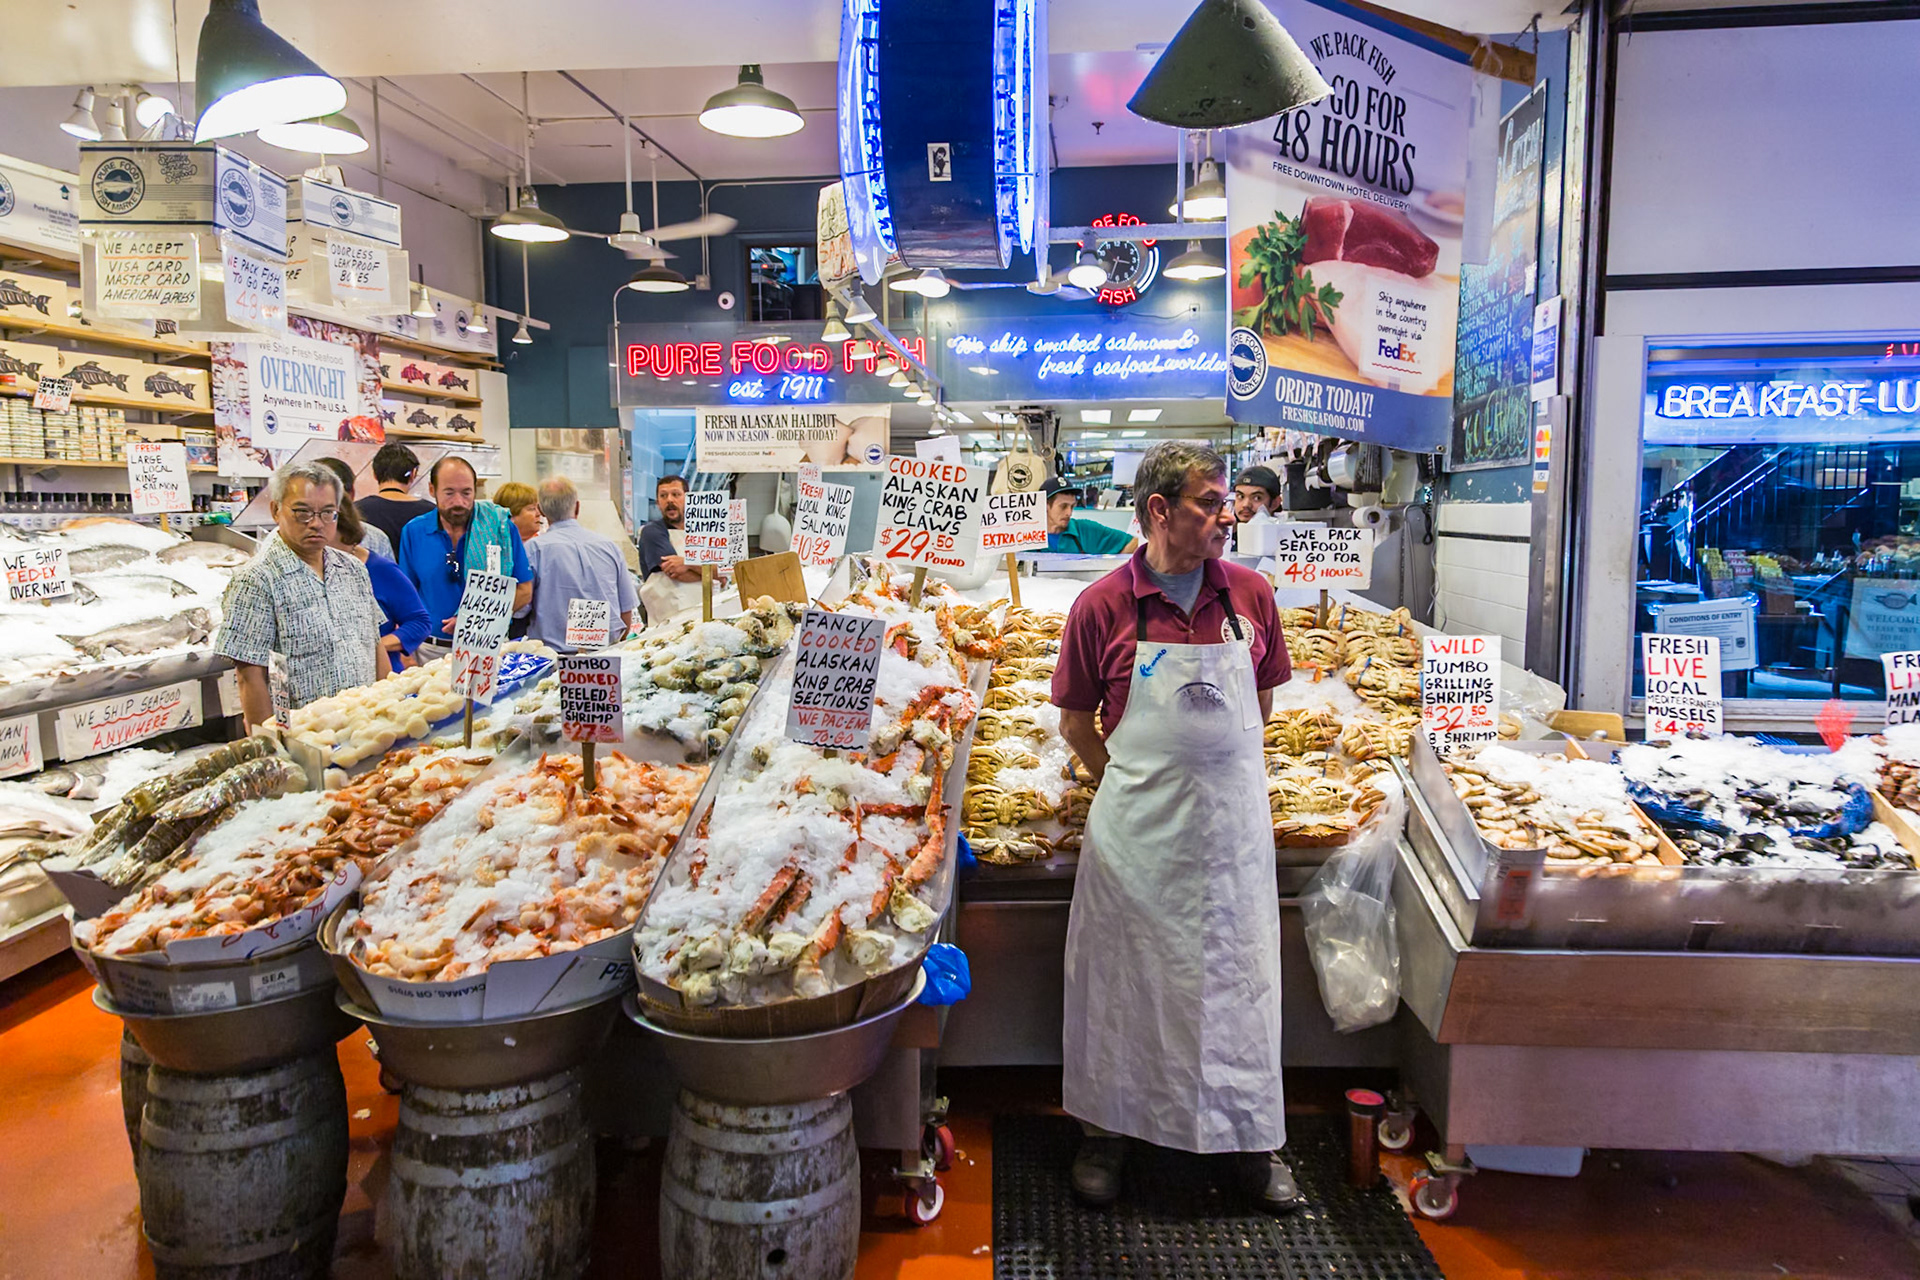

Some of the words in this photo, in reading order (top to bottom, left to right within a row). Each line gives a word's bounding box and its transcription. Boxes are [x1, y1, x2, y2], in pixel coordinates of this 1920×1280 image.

[1310, 33, 1334, 62] WE
[1334, 31, 1368, 63] PACK
[1368, 45, 1396, 86] FISH
[1330, 74, 1360, 120] GO
[1364, 86, 1407, 138] FOR
[1273, 109, 1311, 163] 48
[1318, 114, 1416, 197] HOURS
[97, 162, 116, 180] PURE
[120, 160, 140, 180] FOOD
[1272, 161, 1292, 177] FREE
[1294, 168, 1345, 192] DOWNTOWN
[1346, 186, 1372, 200] HOTEL
[1373, 192, 1412, 211] DELIVERY!
[111, 190, 140, 210] MARKET
[103, 242, 122, 254] WE
[129, 242, 184, 254] ACCEPT
[330, 244, 374, 260] ODORLESS
[109, 261, 140, 272] VISA
[146, 260, 183, 272] CARD
[228, 256, 238, 270] WE
[241, 258, 258, 277] PACK
[261, 267, 282, 285] FISH
[334, 258, 380, 271] LEAKPROOF
[105, 274, 150, 286] MASTER
[156, 272, 191, 286] CARD
[233, 271, 243, 284] TO
[246, 276, 258, 290] GO
[261, 281, 280, 300] FOR
[103, 288, 161, 300] AMERICAN
[1098, 285, 1137, 306] FISH
[1378, 290, 1393, 308] Ship
[1395, 298, 1427, 312] anywhere
[236, 290, 258, 320] 48
[1376, 306, 1383, 316] in
[1386, 308, 1397, 320] the
[1399, 314, 1427, 332] country
[1378, 324, 1408, 342] overnight
[1410, 330, 1422, 341] via
[274, 342, 290, 355] Ship
[313, 350, 344, 366] Seafood
[989, 332, 1028, 358] ship
[1034, 332, 1102, 354] smoked
[1106, 332, 1176, 352] salmon
[1245, 336, 1263, 360] FOOD
[1378, 338, 1416, 364] FedEx
[626, 341, 724, 378] PURE
[730, 340, 834, 375] FOOD
[842, 336, 926, 374] FISH
[1038, 354, 1084, 380] fresh
[1093, 355, 1164, 380] seafood
[260, 355, 346, 400] OVERNIGHT
[728, 379, 766, 399] est.
[778, 376, 824, 400] 1911
[1274, 376, 1322, 409] ORDER
[1326, 385, 1375, 418] TODAY!
[263, 394, 302, 410] Anywhere
[304, 398, 312, 409] In
[314, 400, 327, 412] The
[328, 403, 350, 414] U.S.A.
[704, 414, 738, 430] FRESH
[740, 414, 790, 429] ALASKAN
[791, 414, 838, 428] HALIBUT
[1282, 406, 1366, 433] FRESHSEAFOOD.COM
[704, 430, 726, 442] NOW
[726, 430, 736, 442] IN
[737, 430, 770, 442] SEASON
[776, 430, 806, 441] ORDER
[808, 429, 838, 441] TODAY!
[135, 444, 162, 452] FRESH
[130, 454, 162, 464] LARGE
[136, 474, 158, 483] KING
[142, 465, 172, 474] LOCAL
[889, 458, 968, 483] COOKED
[142, 482, 179, 491] SALMON
[800, 482, 824, 500] FRESH
[827, 486, 852, 505] WILD
[884, 475, 978, 504] ALASKAN
[686, 493, 723, 506] JUMBO
[882, 492, 917, 511] KING
[924, 499, 968, 520] CRAB
[989, 493, 1038, 510] CLEAN
[686, 507, 728, 520] GRILLING
[798, 498, 820, 514] LOCAL
[825, 504, 846, 520] KING
[1005, 510, 1034, 523] FOR
[686, 521, 726, 534] SCAMPIS
[800, 515, 846, 537] SALMON
[893, 510, 960, 536] CLAWS
[685, 536, 707, 546] GREAT
[708, 536, 728, 548] FOR
[982, 532, 1016, 547] EXTRA
[1016, 530, 1046, 544] CHARGE
[1292, 529, 1316, 540] WE
[1328, 529, 1362, 540] PACK
[1280, 539, 1348, 552] SEAFOOD
[3, 555, 28, 570] WE
[36, 548, 62, 566] SHIP
[685, 550, 697, 560] THE
[700, 550, 725, 562] GRILL
[924, 551, 966, 568] POUND
[1280, 554, 1297, 563] TO
[1306, 552, 1326, 563] GO
[1334, 552, 1361, 563] FOR
[1284, 562, 1316, 584] 48
[1320, 567, 1364, 578] HOURS
[468, 573, 509, 596] FRESH
[460, 592, 512, 618] ALASKAN
[464, 614, 496, 632] SPOT
[806, 612, 873, 641] FANCY
[1668, 614, 1710, 624] CONDITIONS
[456, 628, 502, 650] PRAWNS
[801, 631, 876, 654] COOKED
[1430, 638, 1486, 654] WILD
[1648, 637, 1708, 655] FRESH
[558, 657, 610, 670] JUMBO
[796, 650, 876, 674] ALASKAN
[1425, 660, 1489, 675] JUMBO
[1648, 656, 1708, 679] LIVE
[559, 670, 618, 686] COOKED
[793, 671, 830, 691] KING
[834, 676, 876, 694] CRAB
[1424, 678, 1494, 690] GRILLING
[1648, 678, 1707, 696] LOCAL
[560, 686, 608, 702] PEELED
[794, 690, 871, 711] SECTIONS
[1425, 690, 1494, 705] SHRIMPS
[1648, 694, 1724, 708] MEDITERRANEAN
[73, 710, 96, 730] WE
[104, 698, 134, 722] SHIP
[140, 688, 181, 712] SEAFOOD
[560, 700, 620, 713] DEVEINED
[1648, 706, 1717, 724] MUSSELS
[565, 710, 614, 724] SHRIMP
[798, 712, 819, 726] WE
[1424, 705, 1466, 732] $32
[1468, 720, 1494, 728] POUND
[92, 712, 170, 750] ANYWHERE
[1444, 731, 1497, 744] SHRIMP
[262, 971, 286, 984] SEA
